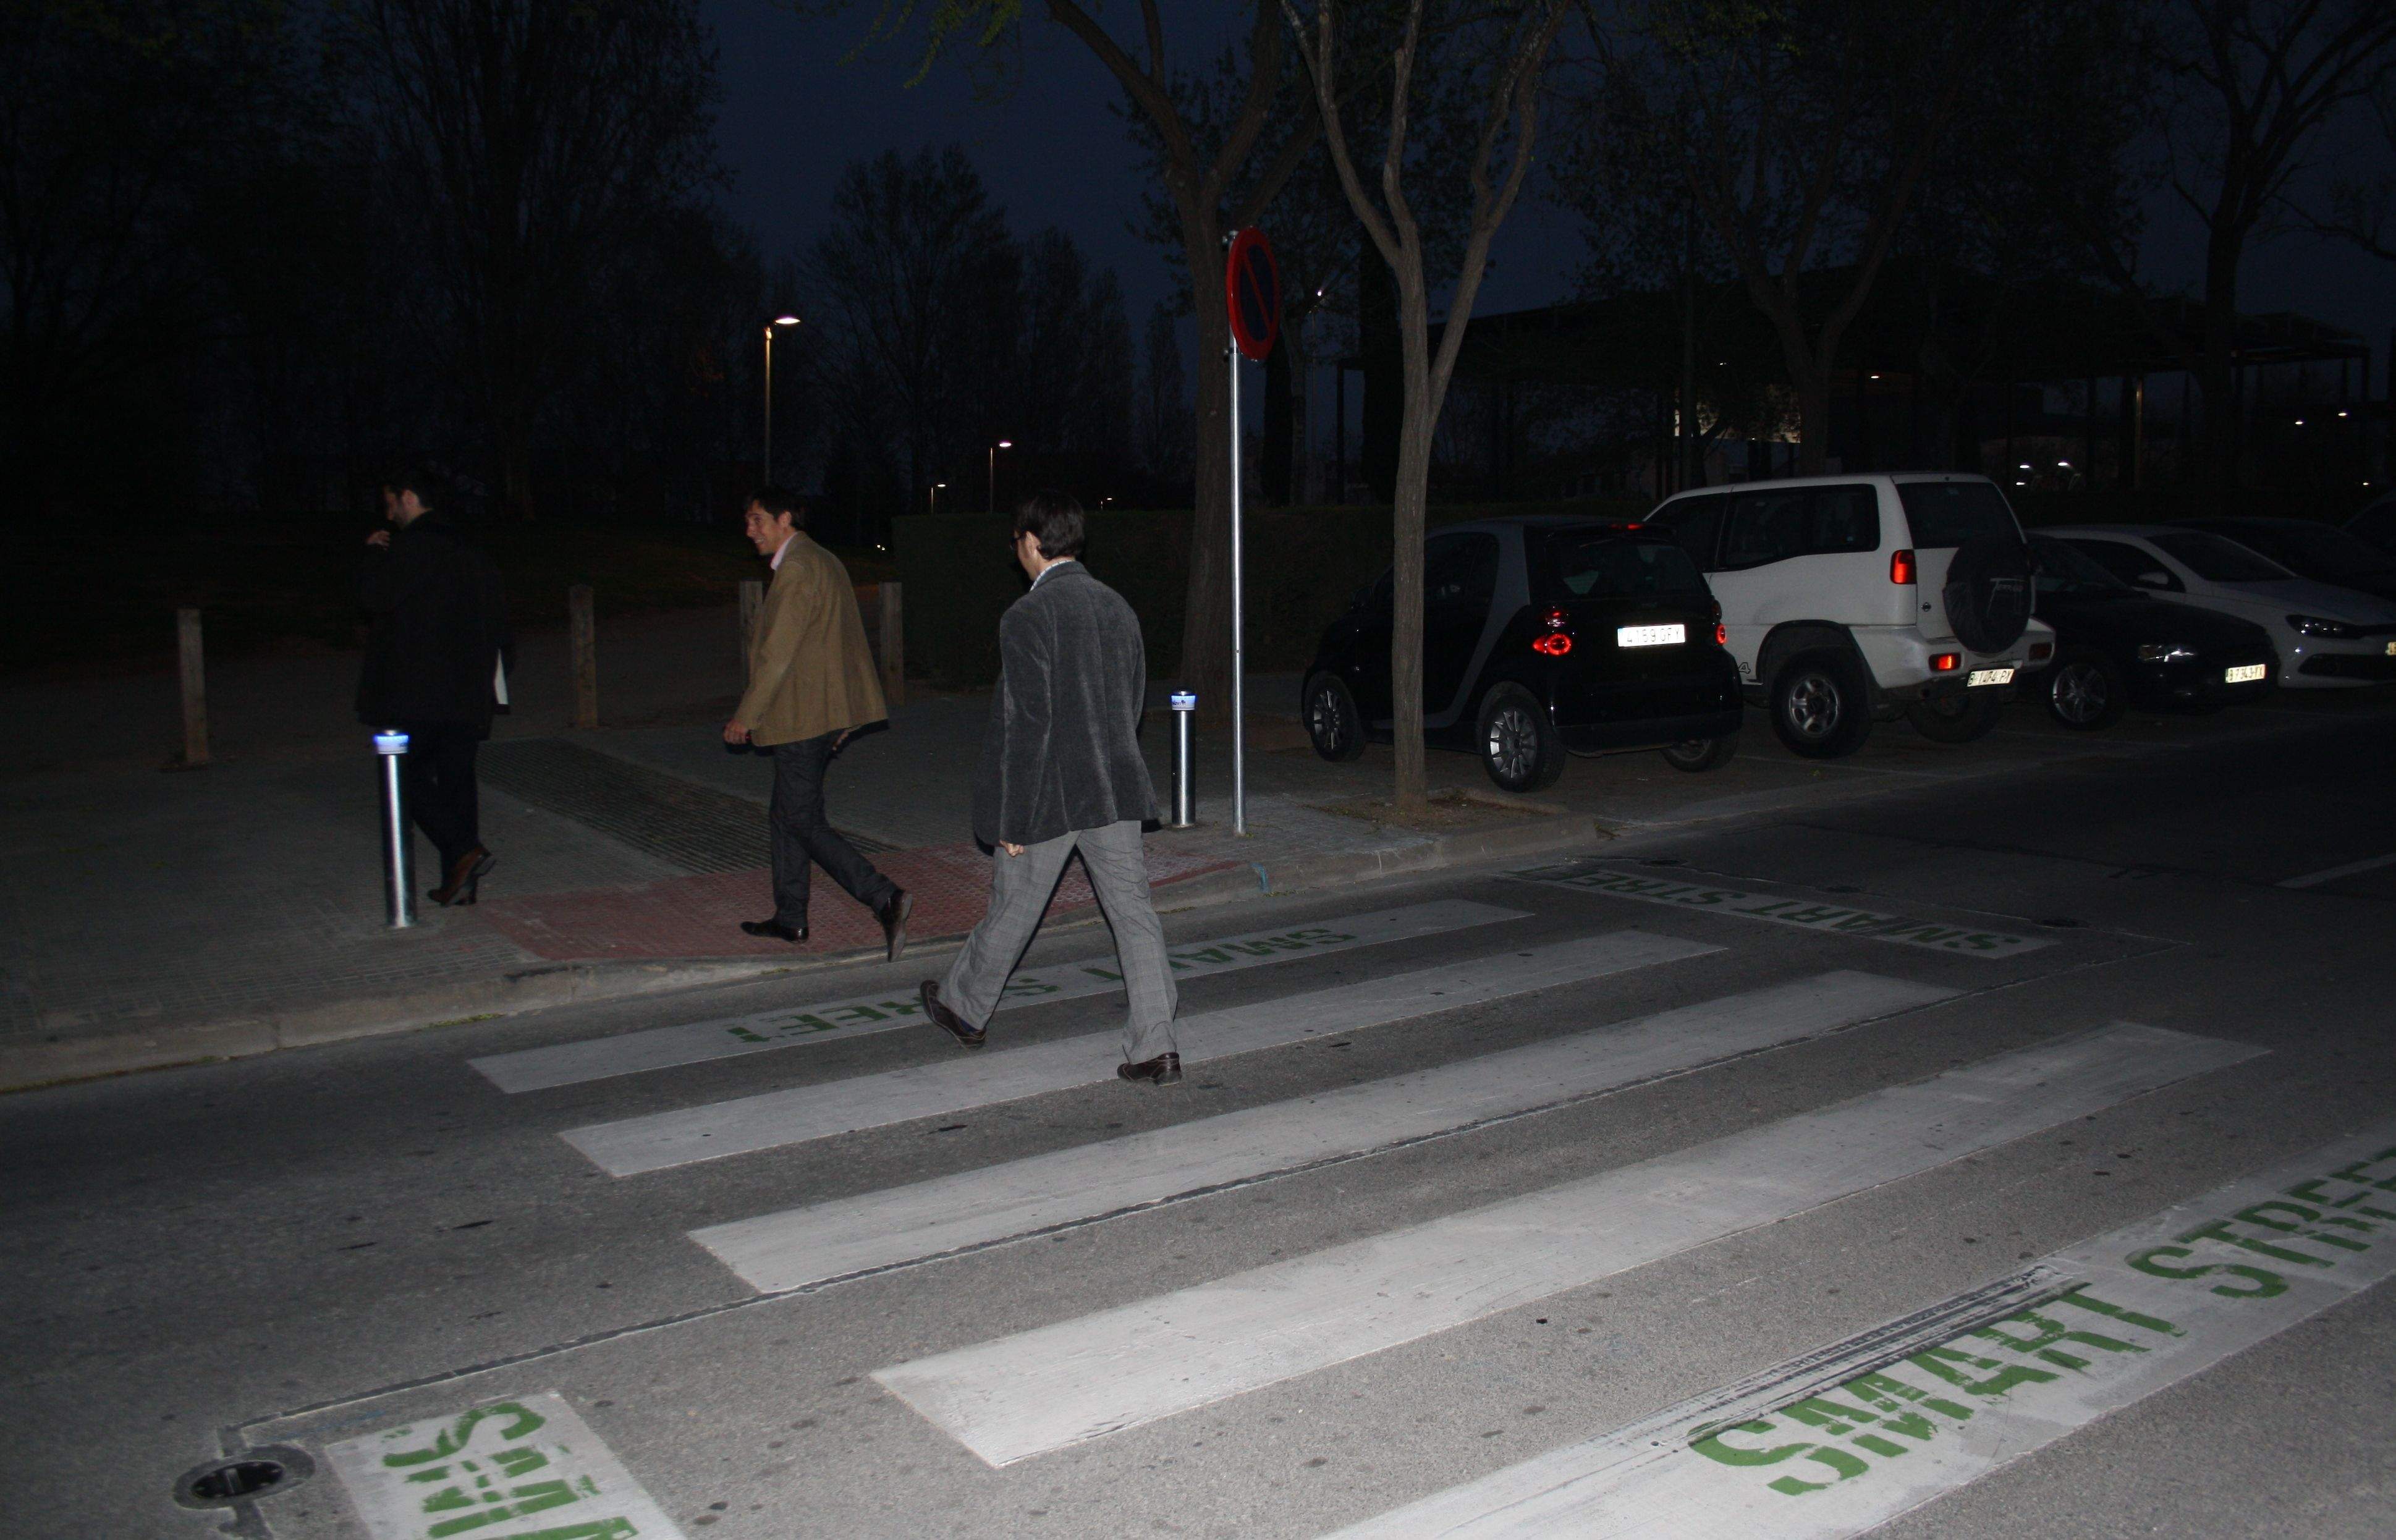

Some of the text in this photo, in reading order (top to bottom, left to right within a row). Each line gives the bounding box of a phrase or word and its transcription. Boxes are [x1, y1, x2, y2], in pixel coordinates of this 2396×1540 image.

[1503, 864, 2021, 950] SMART STREET
[1080, 929, 1357, 983] SMAT
[1688, 1280, 2188, 1496] SMART
